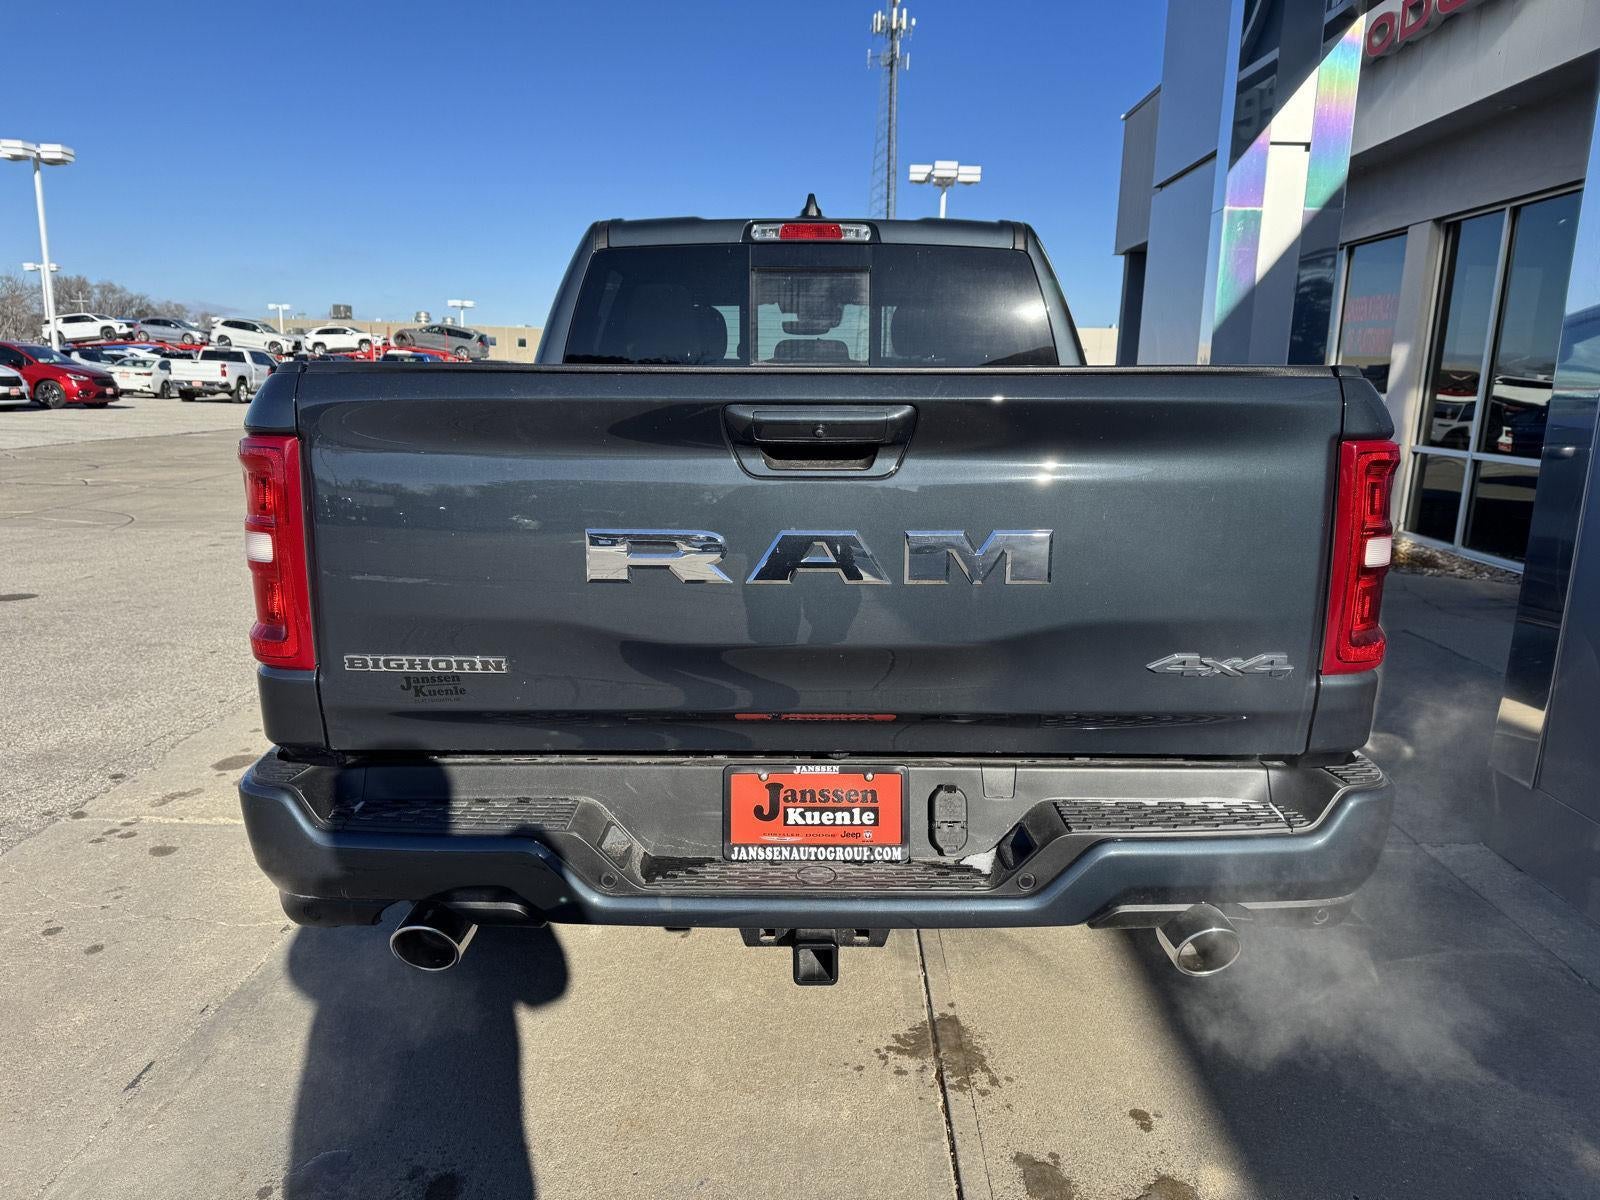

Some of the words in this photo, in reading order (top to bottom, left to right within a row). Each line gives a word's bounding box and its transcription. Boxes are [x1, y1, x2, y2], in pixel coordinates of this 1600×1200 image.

[1363, 0, 1470, 57] OD
[585, 528, 1054, 585] RAM
[344, 655, 508, 673] BIGHORN
[400, 674, 461, 691] Janssen
[413, 685, 466, 697] Kuenle
[793, 765, 840, 774] JANSSEN
[753, 782, 879, 822] Janssen
[786, 808, 875, 825] Kuenle
[840, 830, 861, 839] Jeep
[731, 846, 902, 861] JANSSENAUTOGROUP.COM
